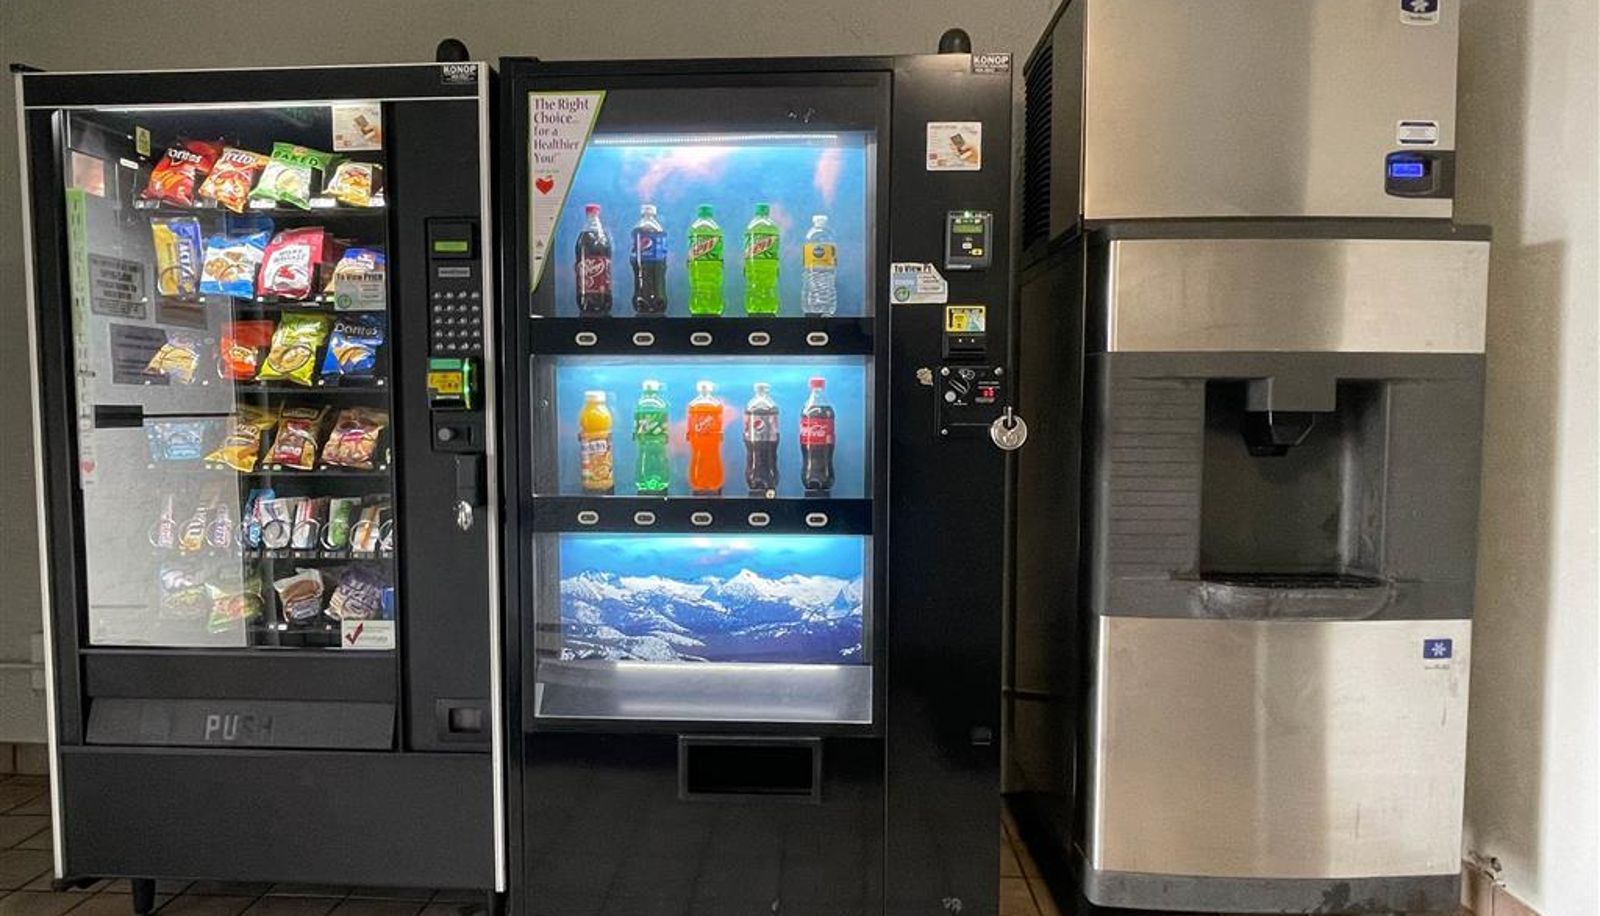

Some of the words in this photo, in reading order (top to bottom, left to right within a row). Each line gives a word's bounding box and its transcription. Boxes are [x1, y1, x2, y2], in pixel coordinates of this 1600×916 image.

[974, 55, 1009, 65] KONOP
[443, 64, 477, 74] KONOP
[535, 97, 555, 110] The
[558, 97, 589, 113] Right
[534, 126, 549, 136] for
[552, 128, 559, 136] a
[534, 138, 580, 150] Healthier
[534, 152, 554, 163] You
[363, 271, 384, 281] Price
[334, 322, 378, 336] Doritos
[204, 714, 275, 741] PUSH
